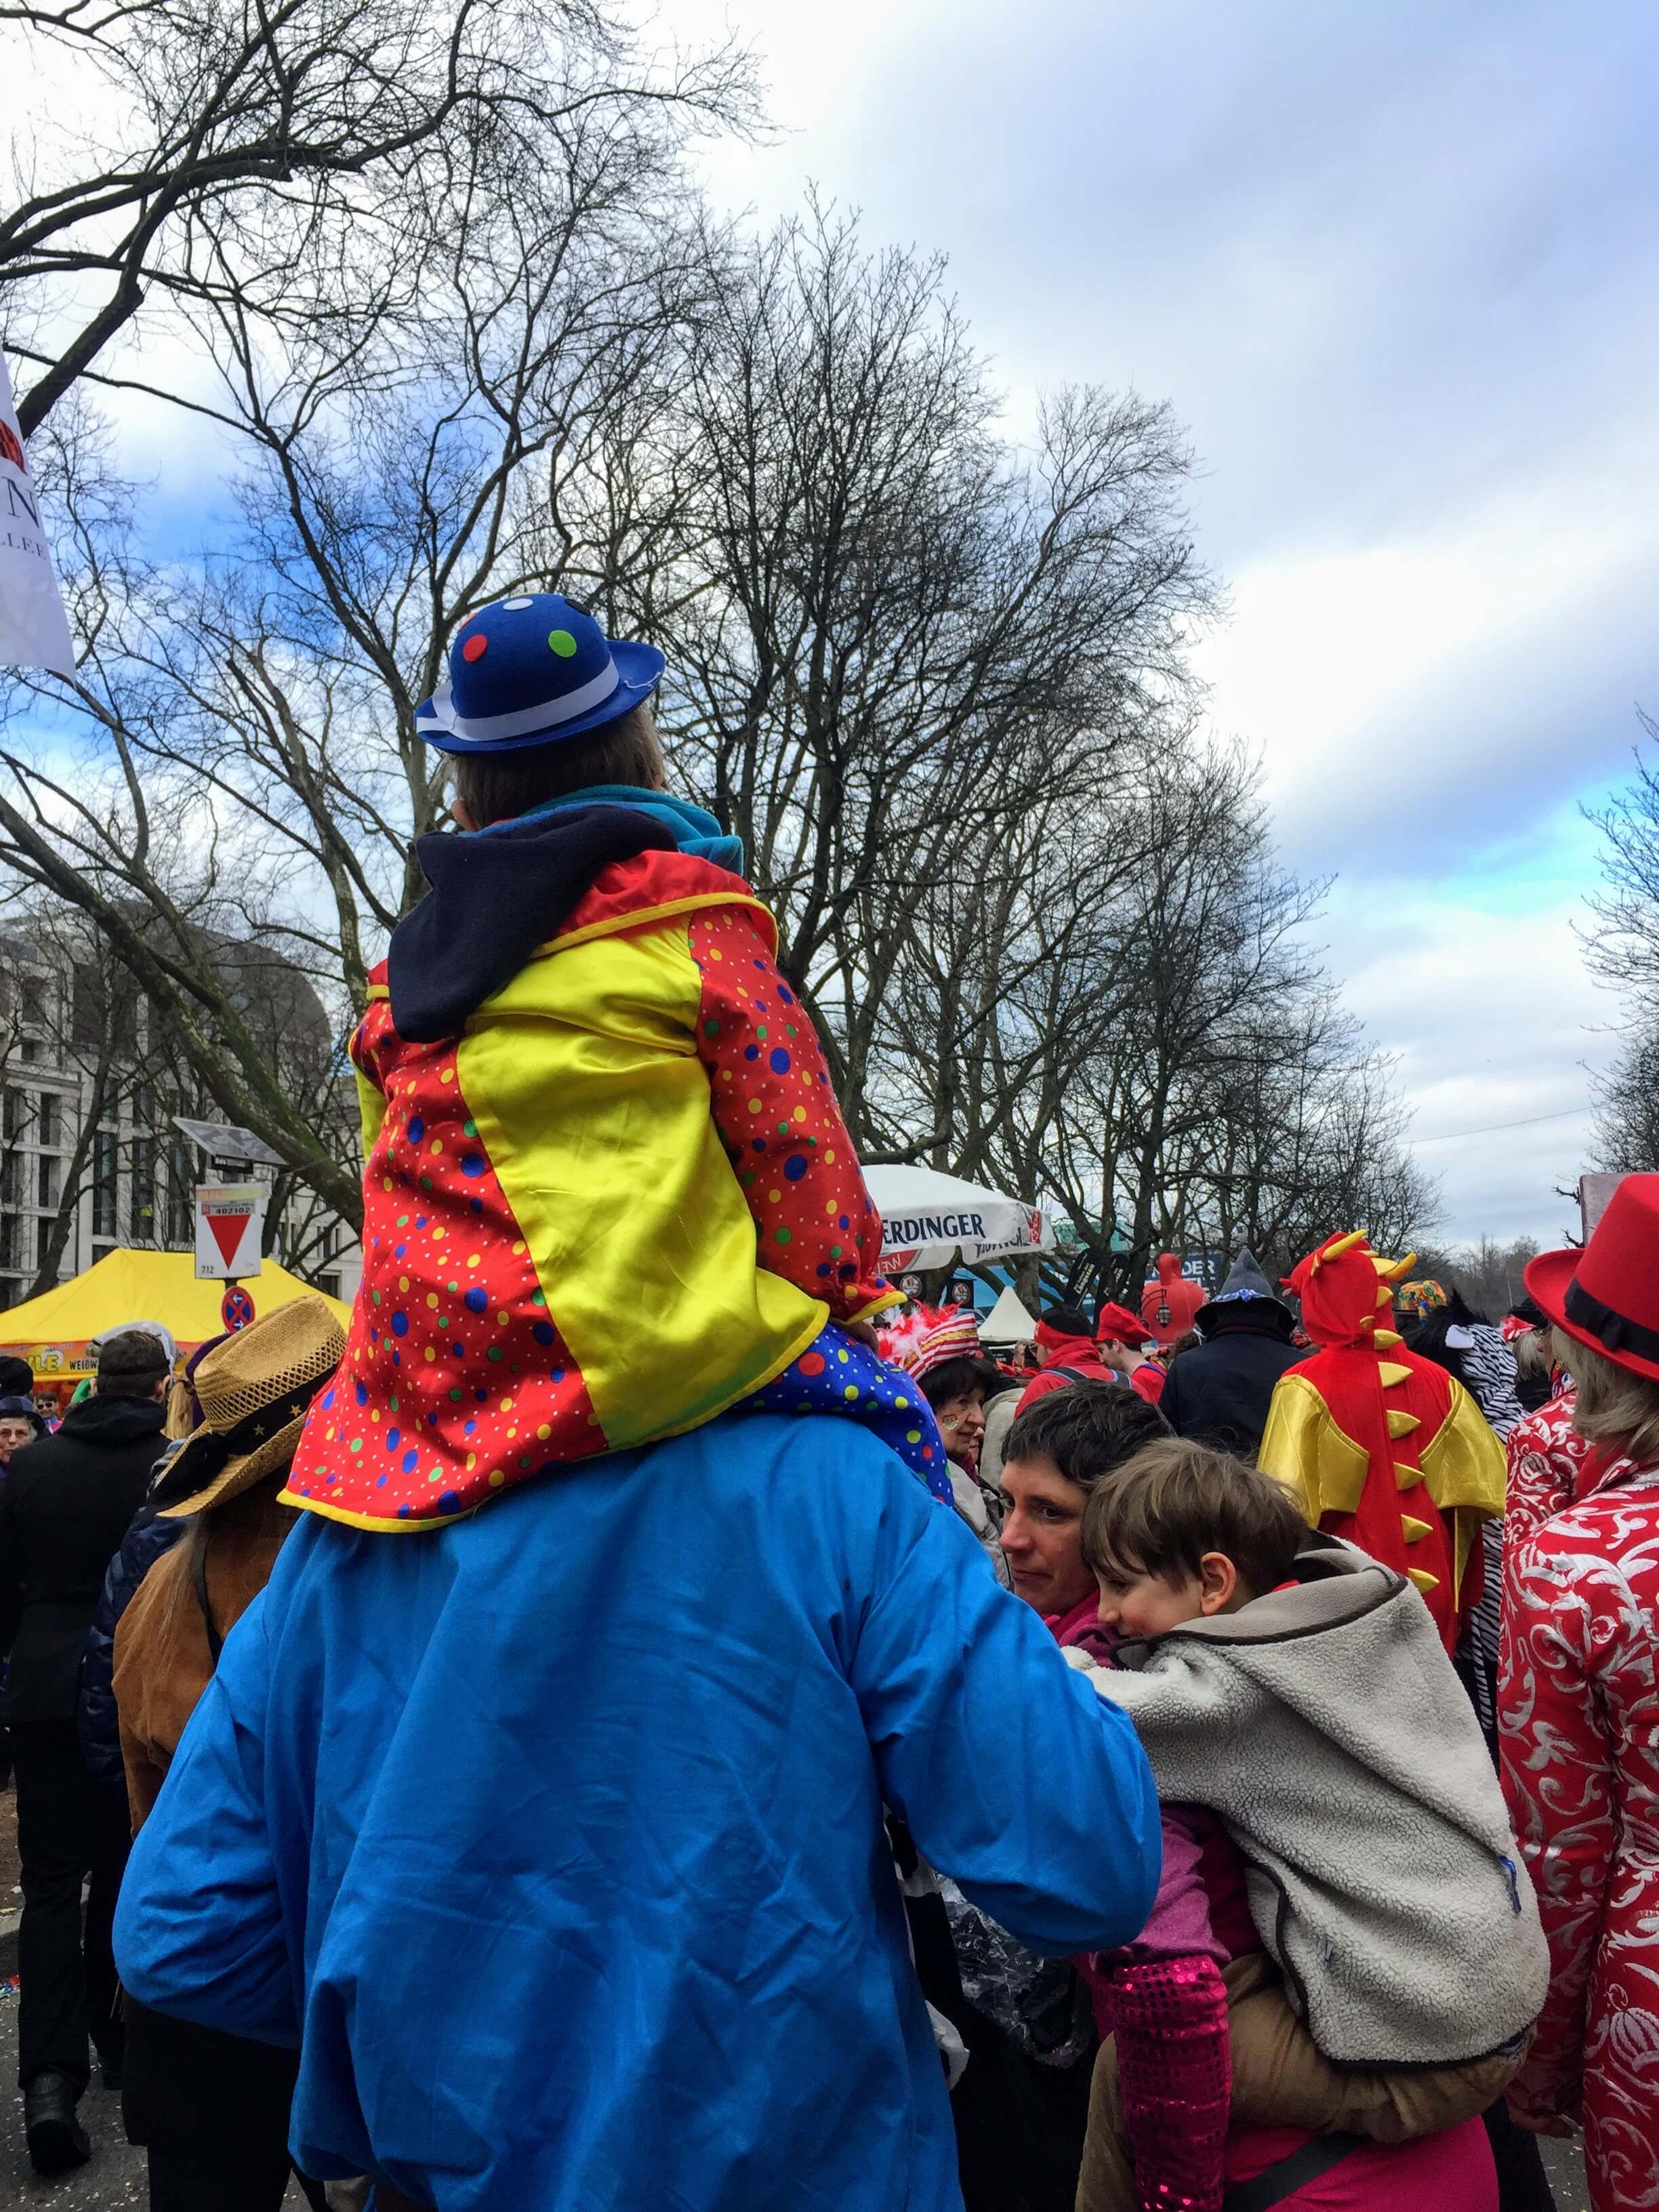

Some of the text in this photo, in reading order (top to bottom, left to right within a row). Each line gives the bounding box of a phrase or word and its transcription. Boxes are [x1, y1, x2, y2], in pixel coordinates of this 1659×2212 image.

[1, 476, 40, 529] N
[0, 532, 47, 560] LEE
[882, 1214, 987, 1244] ERDINGER
[201, 1265, 214, 1274] 712
